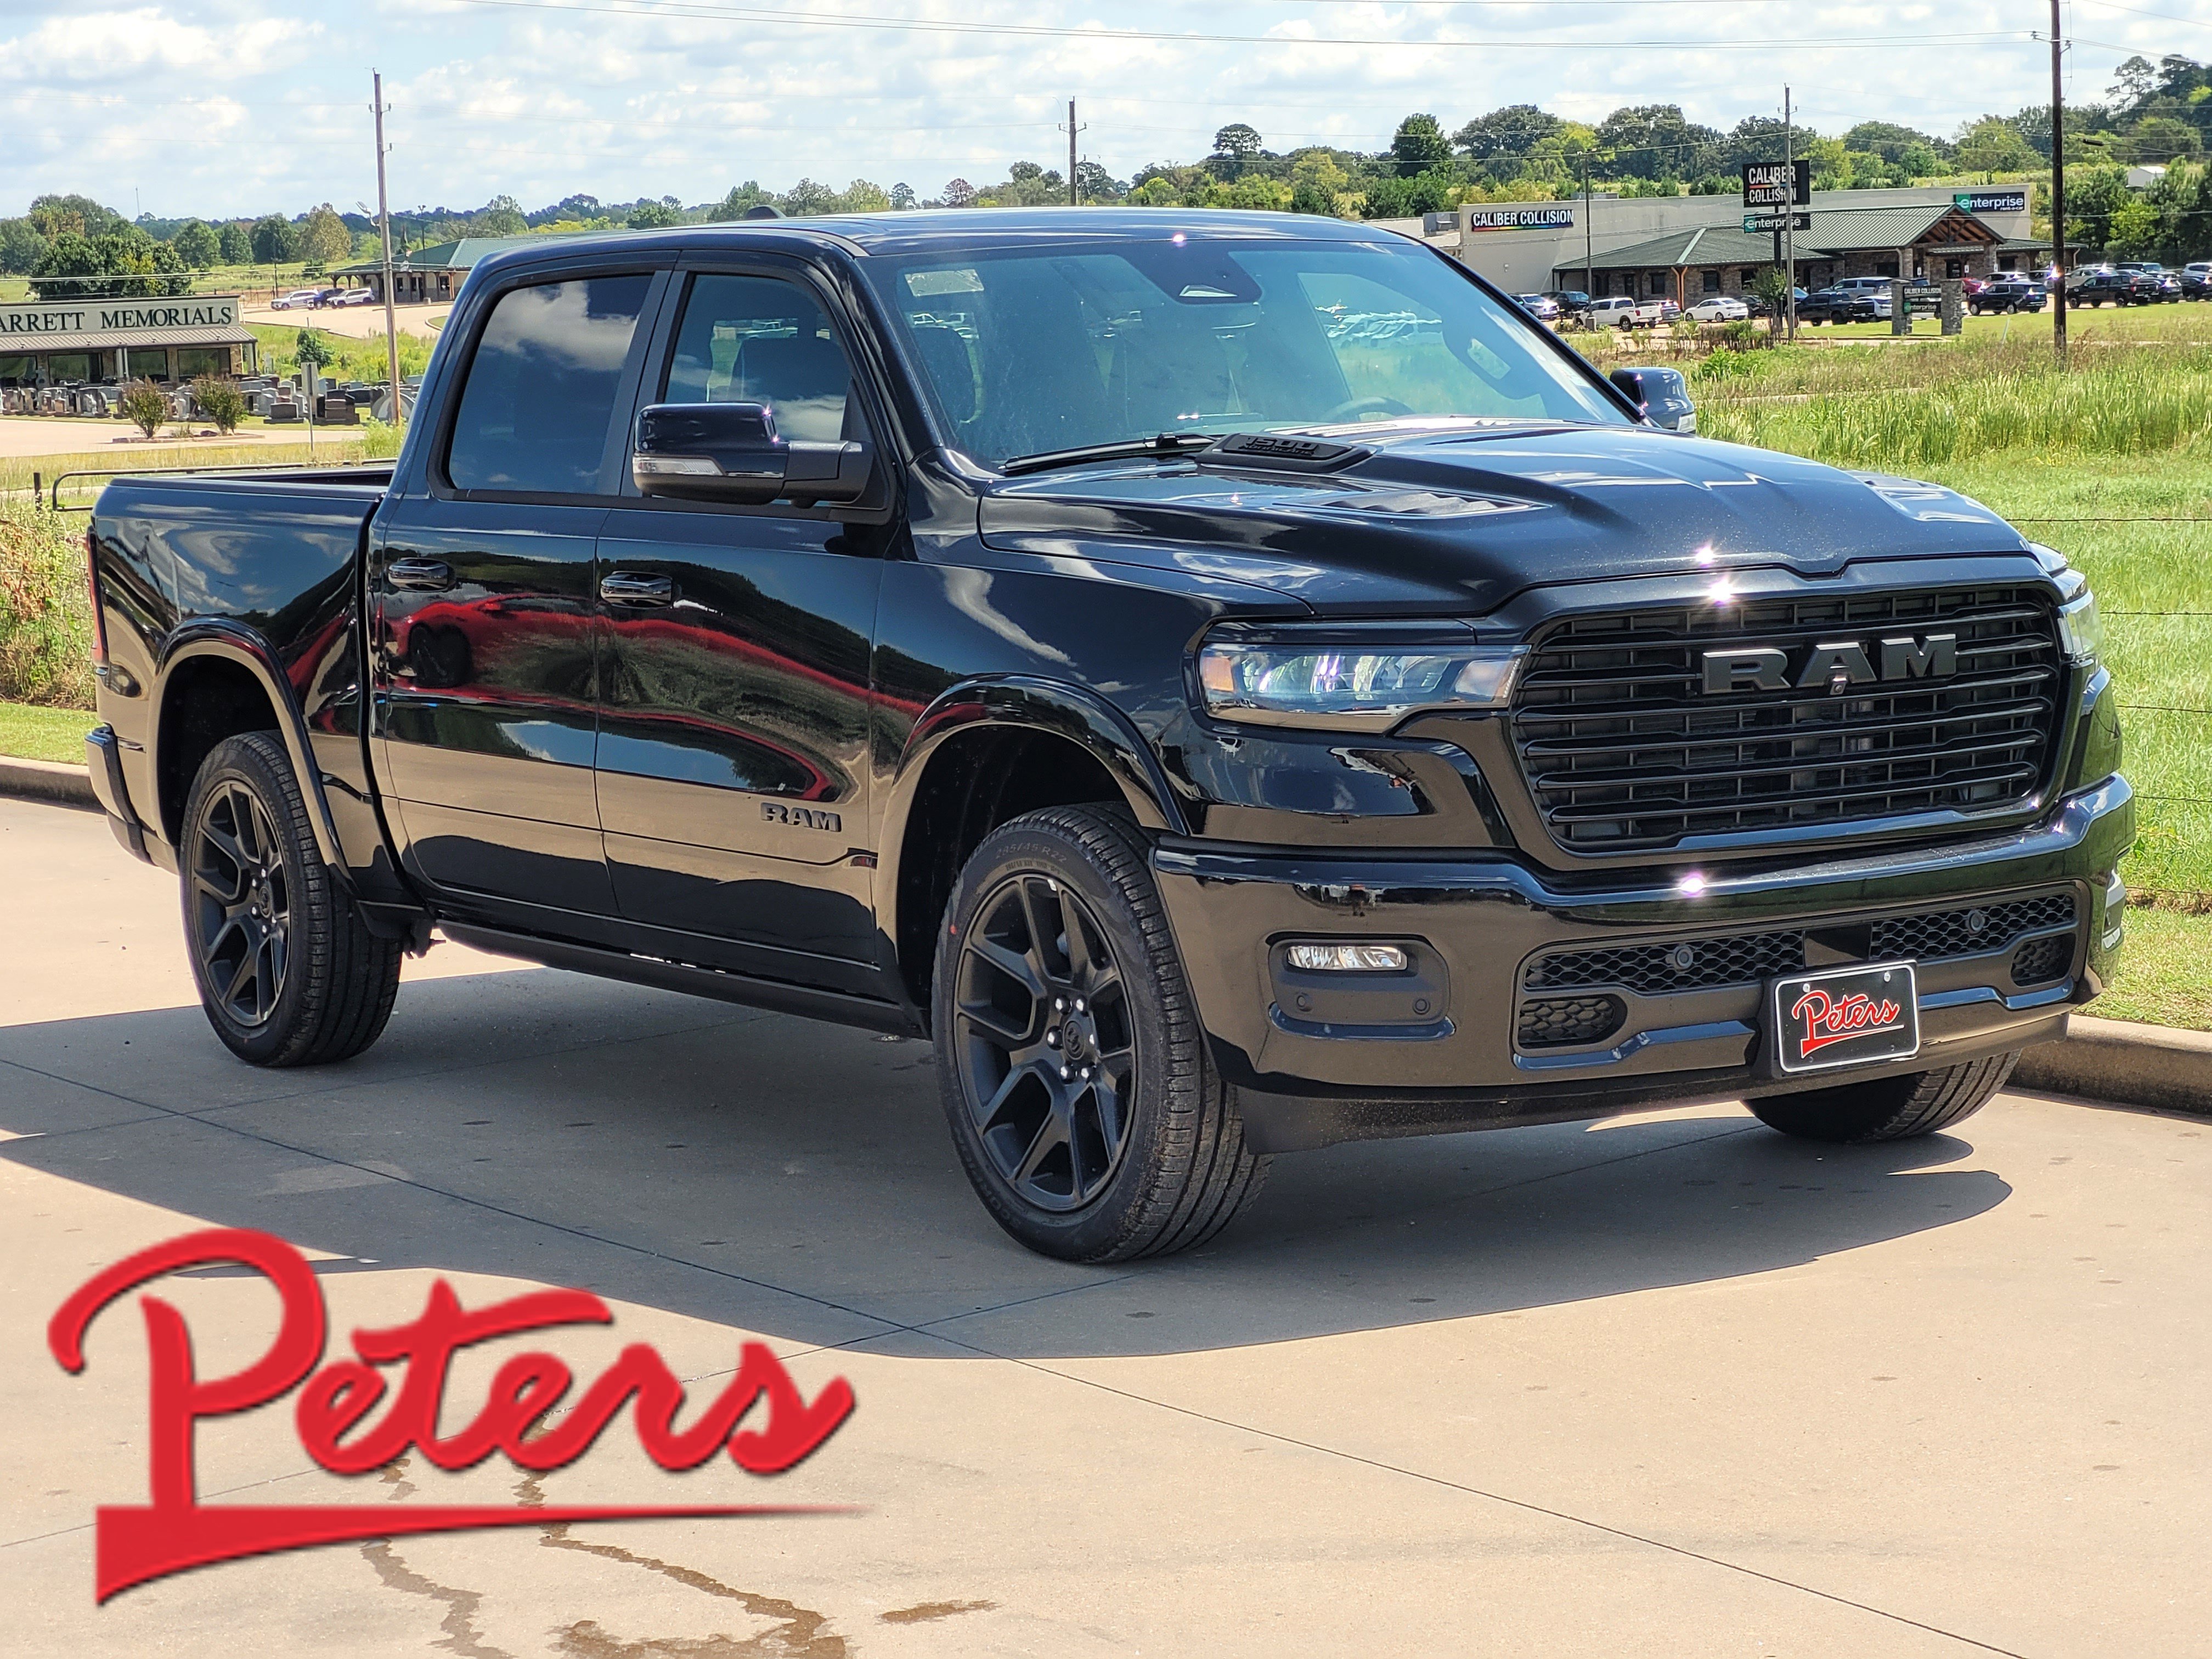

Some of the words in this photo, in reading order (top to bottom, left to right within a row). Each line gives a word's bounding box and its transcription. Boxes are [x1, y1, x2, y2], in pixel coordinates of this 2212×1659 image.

[1748, 166, 1796, 184] CALIBER
[1749, 187, 1797, 203] COLLISIN
[1956, 196, 2024, 210] enterprise
[1473, 212, 1517, 226] CALIBER
[1520, 210, 1574, 224] COLLISION
[1746, 218, 1801, 229] enterprse
[100, 307, 232, 329] MEMORIALS
[1246, 437, 1319, 452] 1500
[1702, 634, 1956, 695] RAM
[760, 802, 842, 832] RAM
[1791, 989, 1902, 1058] Peters
